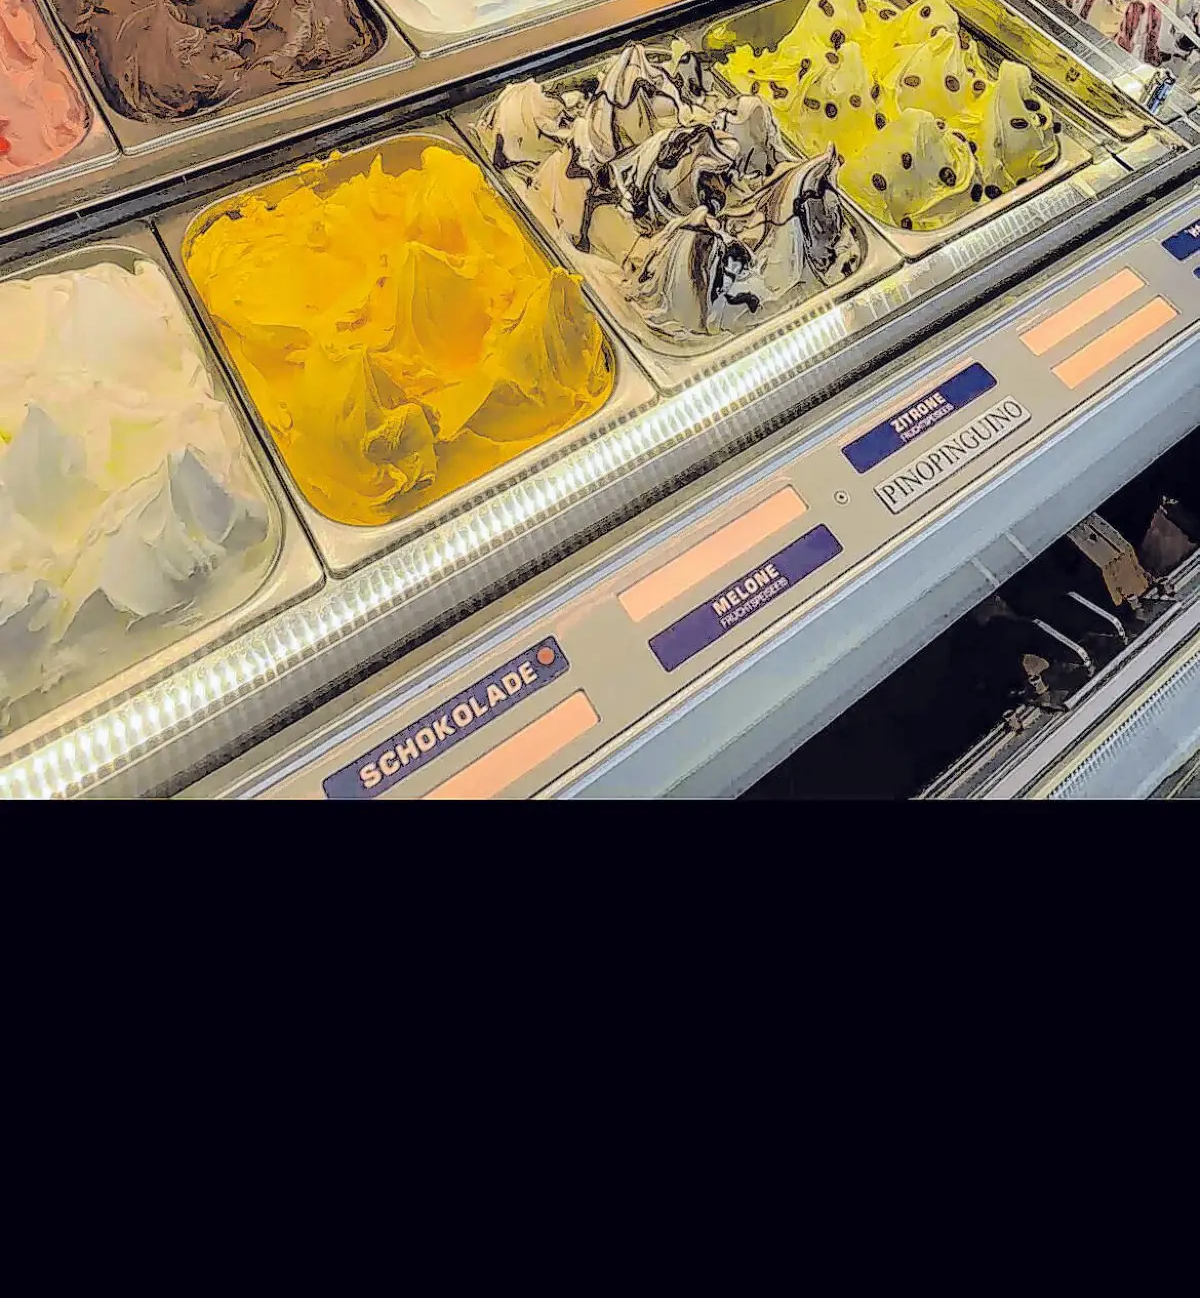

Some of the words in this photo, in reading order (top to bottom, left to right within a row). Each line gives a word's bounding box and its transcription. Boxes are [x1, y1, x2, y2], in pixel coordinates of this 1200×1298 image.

[890, 392, 946, 433] ZITRONE
[881, 400, 1022, 505] PINOPINGUINO
[712, 563, 779, 616] MELONE
[359, 660, 537, 789] SCHOKOLADE
